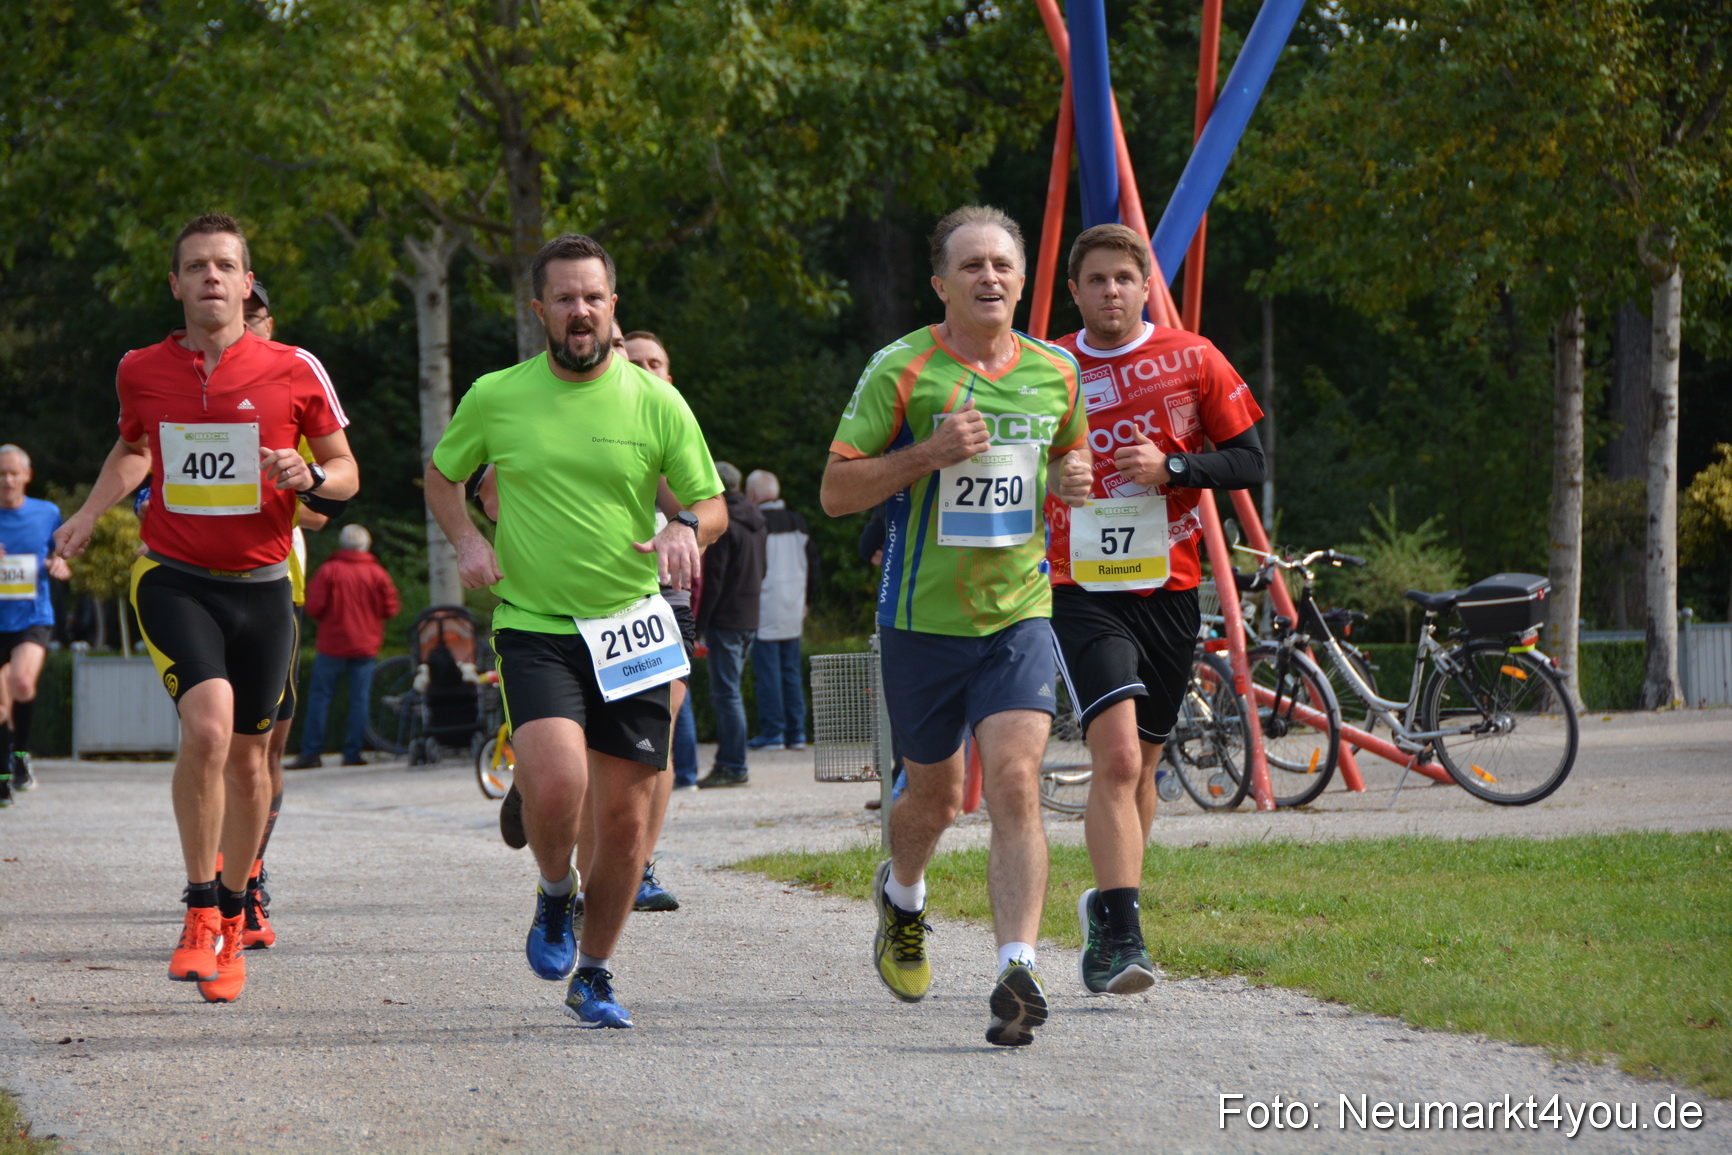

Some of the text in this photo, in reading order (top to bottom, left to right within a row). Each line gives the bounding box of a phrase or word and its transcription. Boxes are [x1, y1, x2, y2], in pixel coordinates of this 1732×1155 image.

[1128, 378, 1181, 400] schenken
[194, 432, 230, 441] BOCK
[591, 436, 647, 448] Dorfner-Apotheken
[182, 452, 236, 480] 402
[981, 454, 1014, 464] BOCK
[955, 475, 1023, 507] 2750
[1103, 506, 1139, 515] BOCK
[1100, 526, 1136, 556] 57
[1098, 563, 1143, 576] Raimund
[600, 614, 665, 661] 2190
[622, 656, 664, 678] Christian
